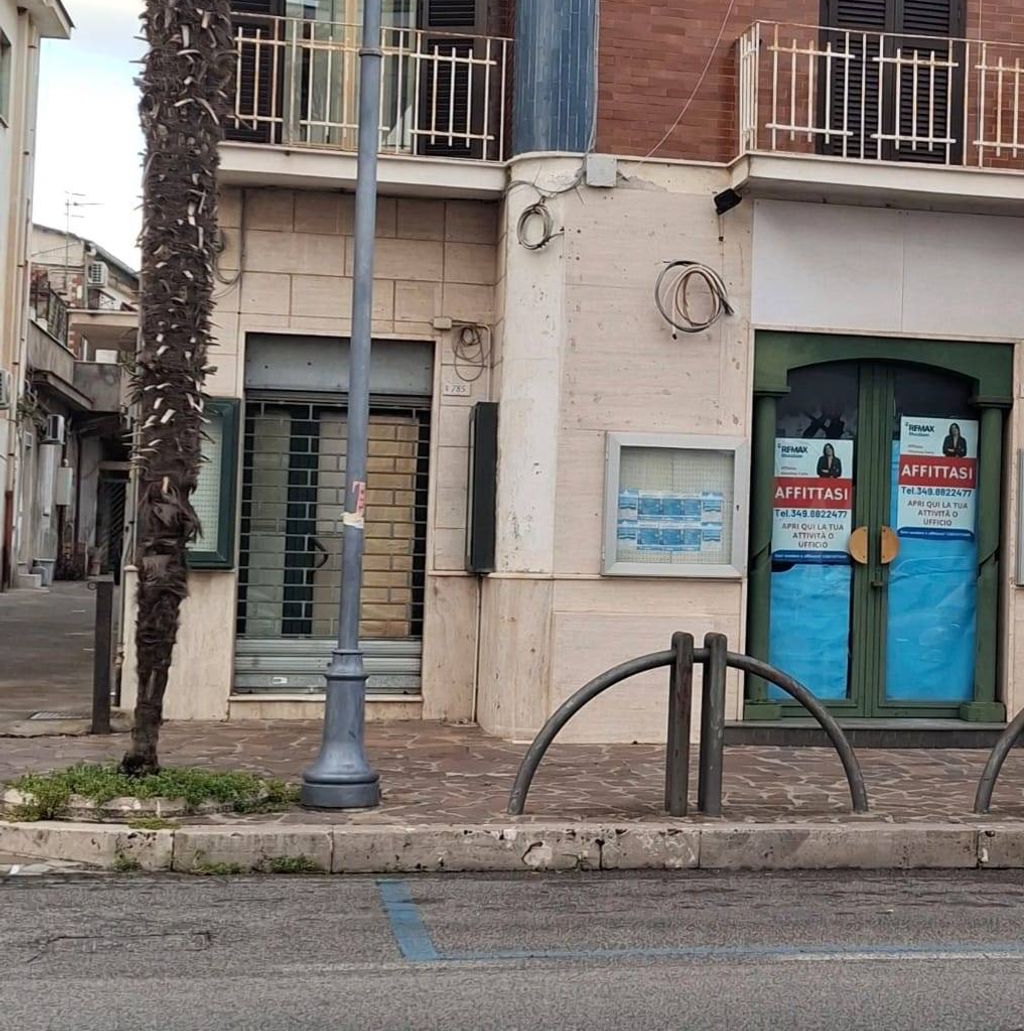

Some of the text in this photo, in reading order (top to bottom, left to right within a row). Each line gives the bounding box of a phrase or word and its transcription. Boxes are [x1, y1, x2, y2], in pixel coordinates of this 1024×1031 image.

[901, 463, 973, 480] AFFITTASI
[774, 486, 849, 502] AFFITTASI
[907, 500, 968, 510] APRI QUI LA TUA
[923, 518, 952, 527] UFFICIO
[800, 523, 815, 532] QUI
[817, 523, 827, 531] LA
[828, 523, 844, 531] TUA
[798, 540, 828, 549] UFFICIO
